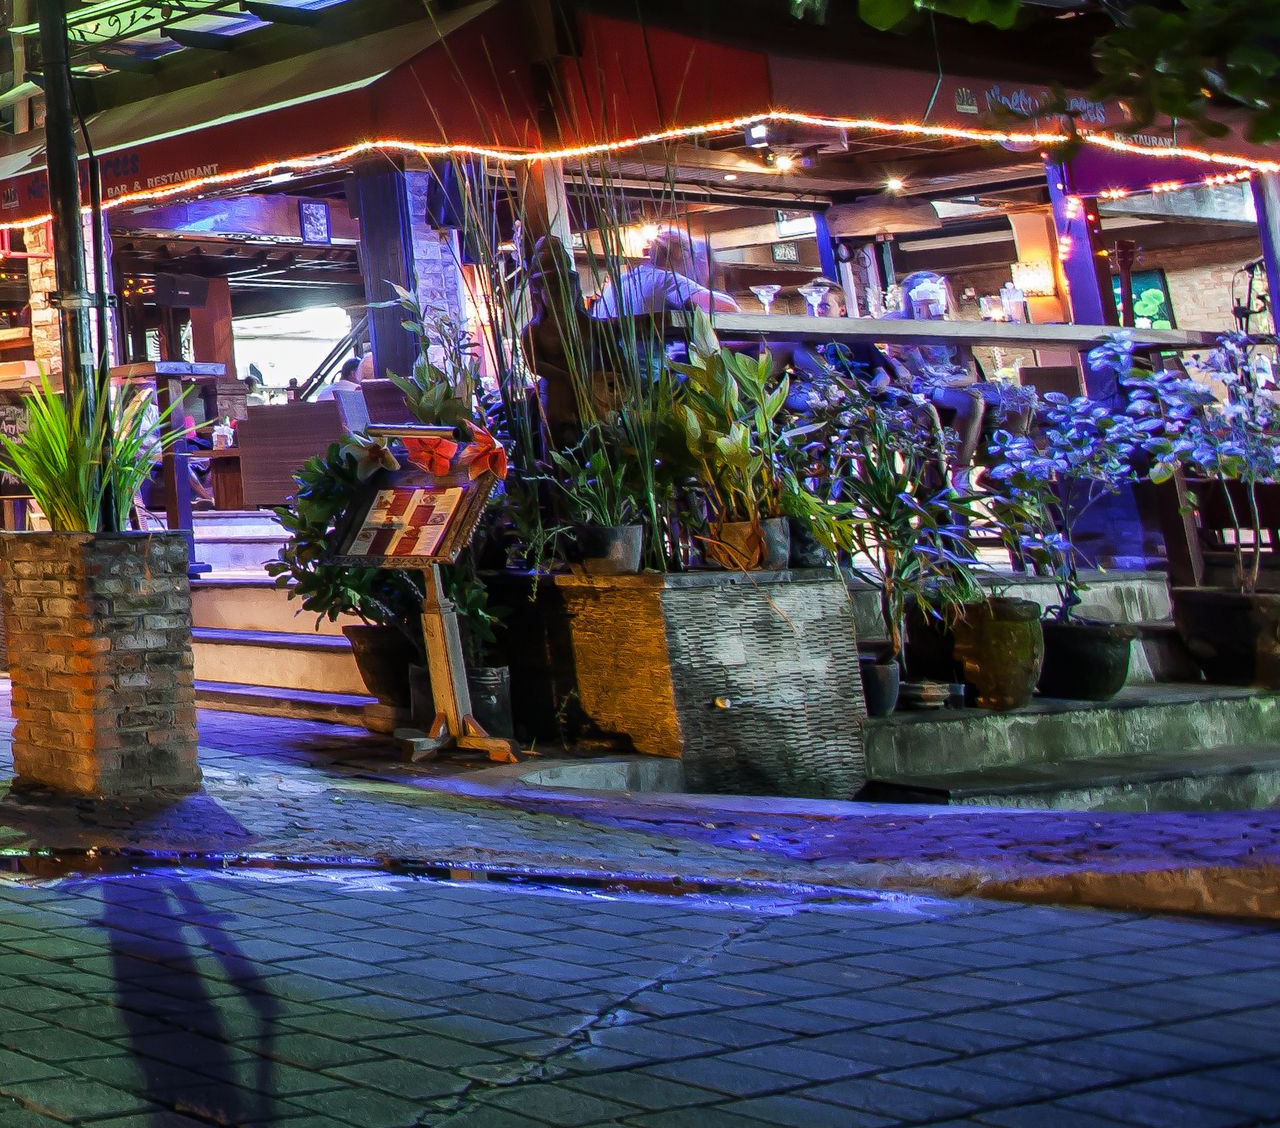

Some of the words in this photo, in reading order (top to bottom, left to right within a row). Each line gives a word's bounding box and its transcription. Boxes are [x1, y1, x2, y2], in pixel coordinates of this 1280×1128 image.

[107, 183, 128, 198] BAR
[133, 181, 142, 191] &
[147, 163, 218, 189] RESTAURANT
